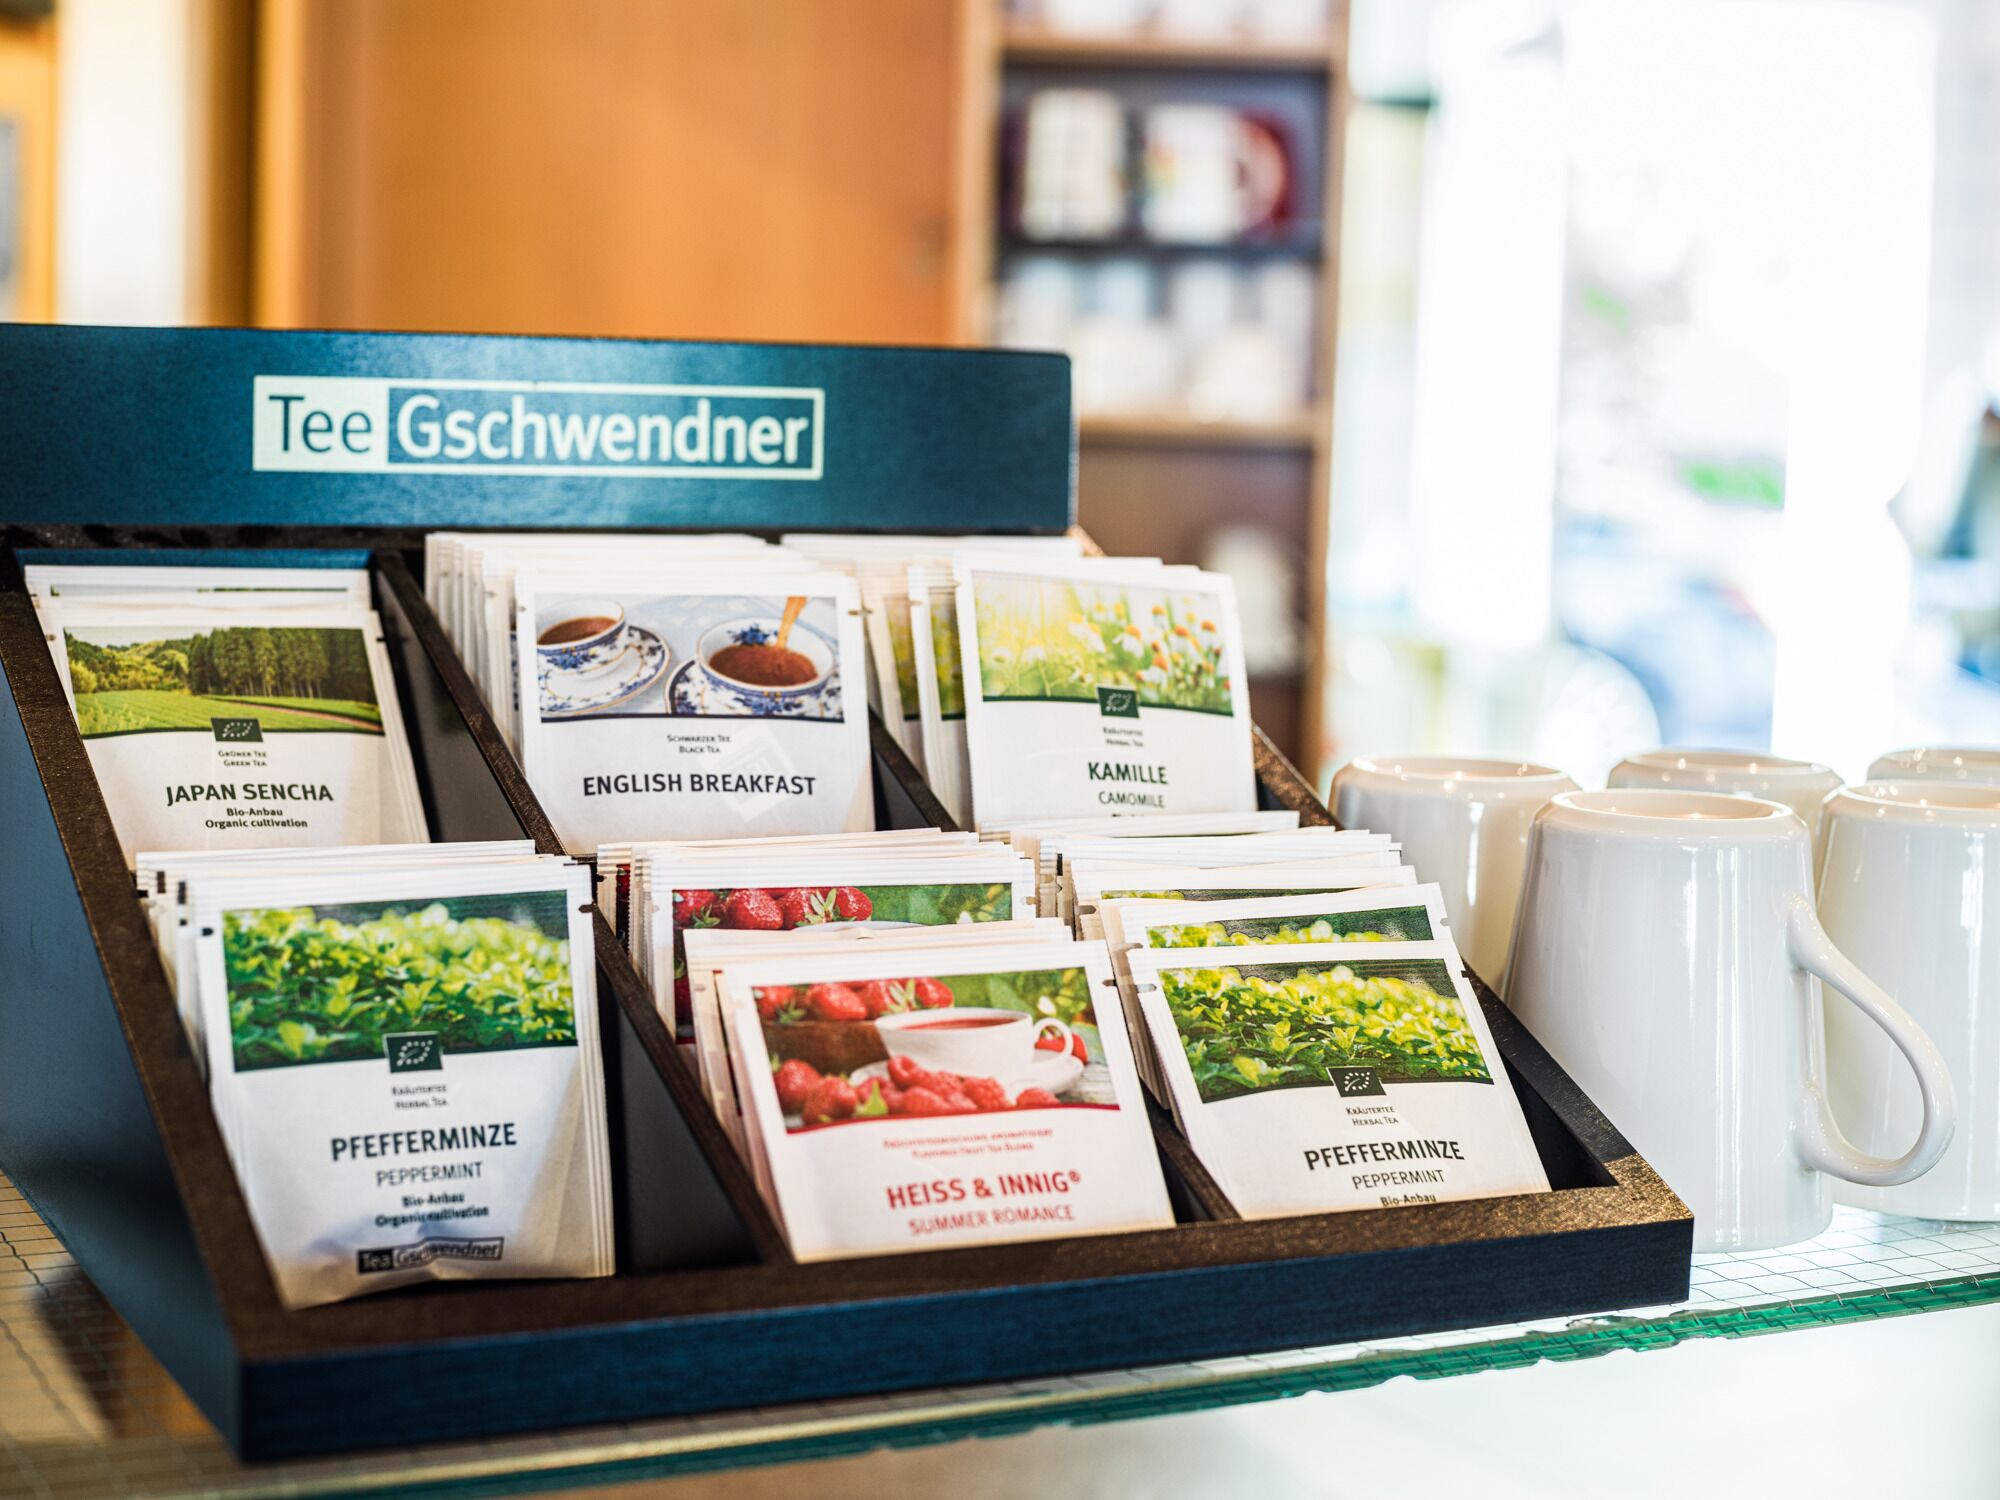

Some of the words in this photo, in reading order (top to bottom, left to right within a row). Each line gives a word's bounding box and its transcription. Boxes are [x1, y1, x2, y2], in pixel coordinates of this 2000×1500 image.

[267, 394, 373, 454] Tee
[396, 394, 809, 465] Gschwendner
[583, 773, 683, 796] ENGLISH
[690, 773, 816, 796] BREAKFAST
[1088, 761, 1169, 785] KAMILLE
[166, 784, 237, 807] JAPAN
[242, 784, 334, 801] SENCHA
[1098, 790, 1166, 809] CAMOMILE
[226, 807, 284, 817] Bio-Anbau
[205, 819, 249, 830] Organic
[250, 818, 308, 828] cultivation
[331, 1122, 517, 1162] PFEFFERMINZE
[1304, 1139, 1465, 1171] PFEFFERMINZE
[376, 1161, 483, 1188] PEPPERMINT
[1352, 1169, 1445, 1190] PEPPERMINT
[886, 1178, 967, 1210] HEISS
[973, 1177, 993, 1199] &
[1380, 1193, 1437, 1208] Bio-Anbau
[908, 1209, 989, 1236] SUMMER
[992, 1203, 1075, 1225] ROMANCE
